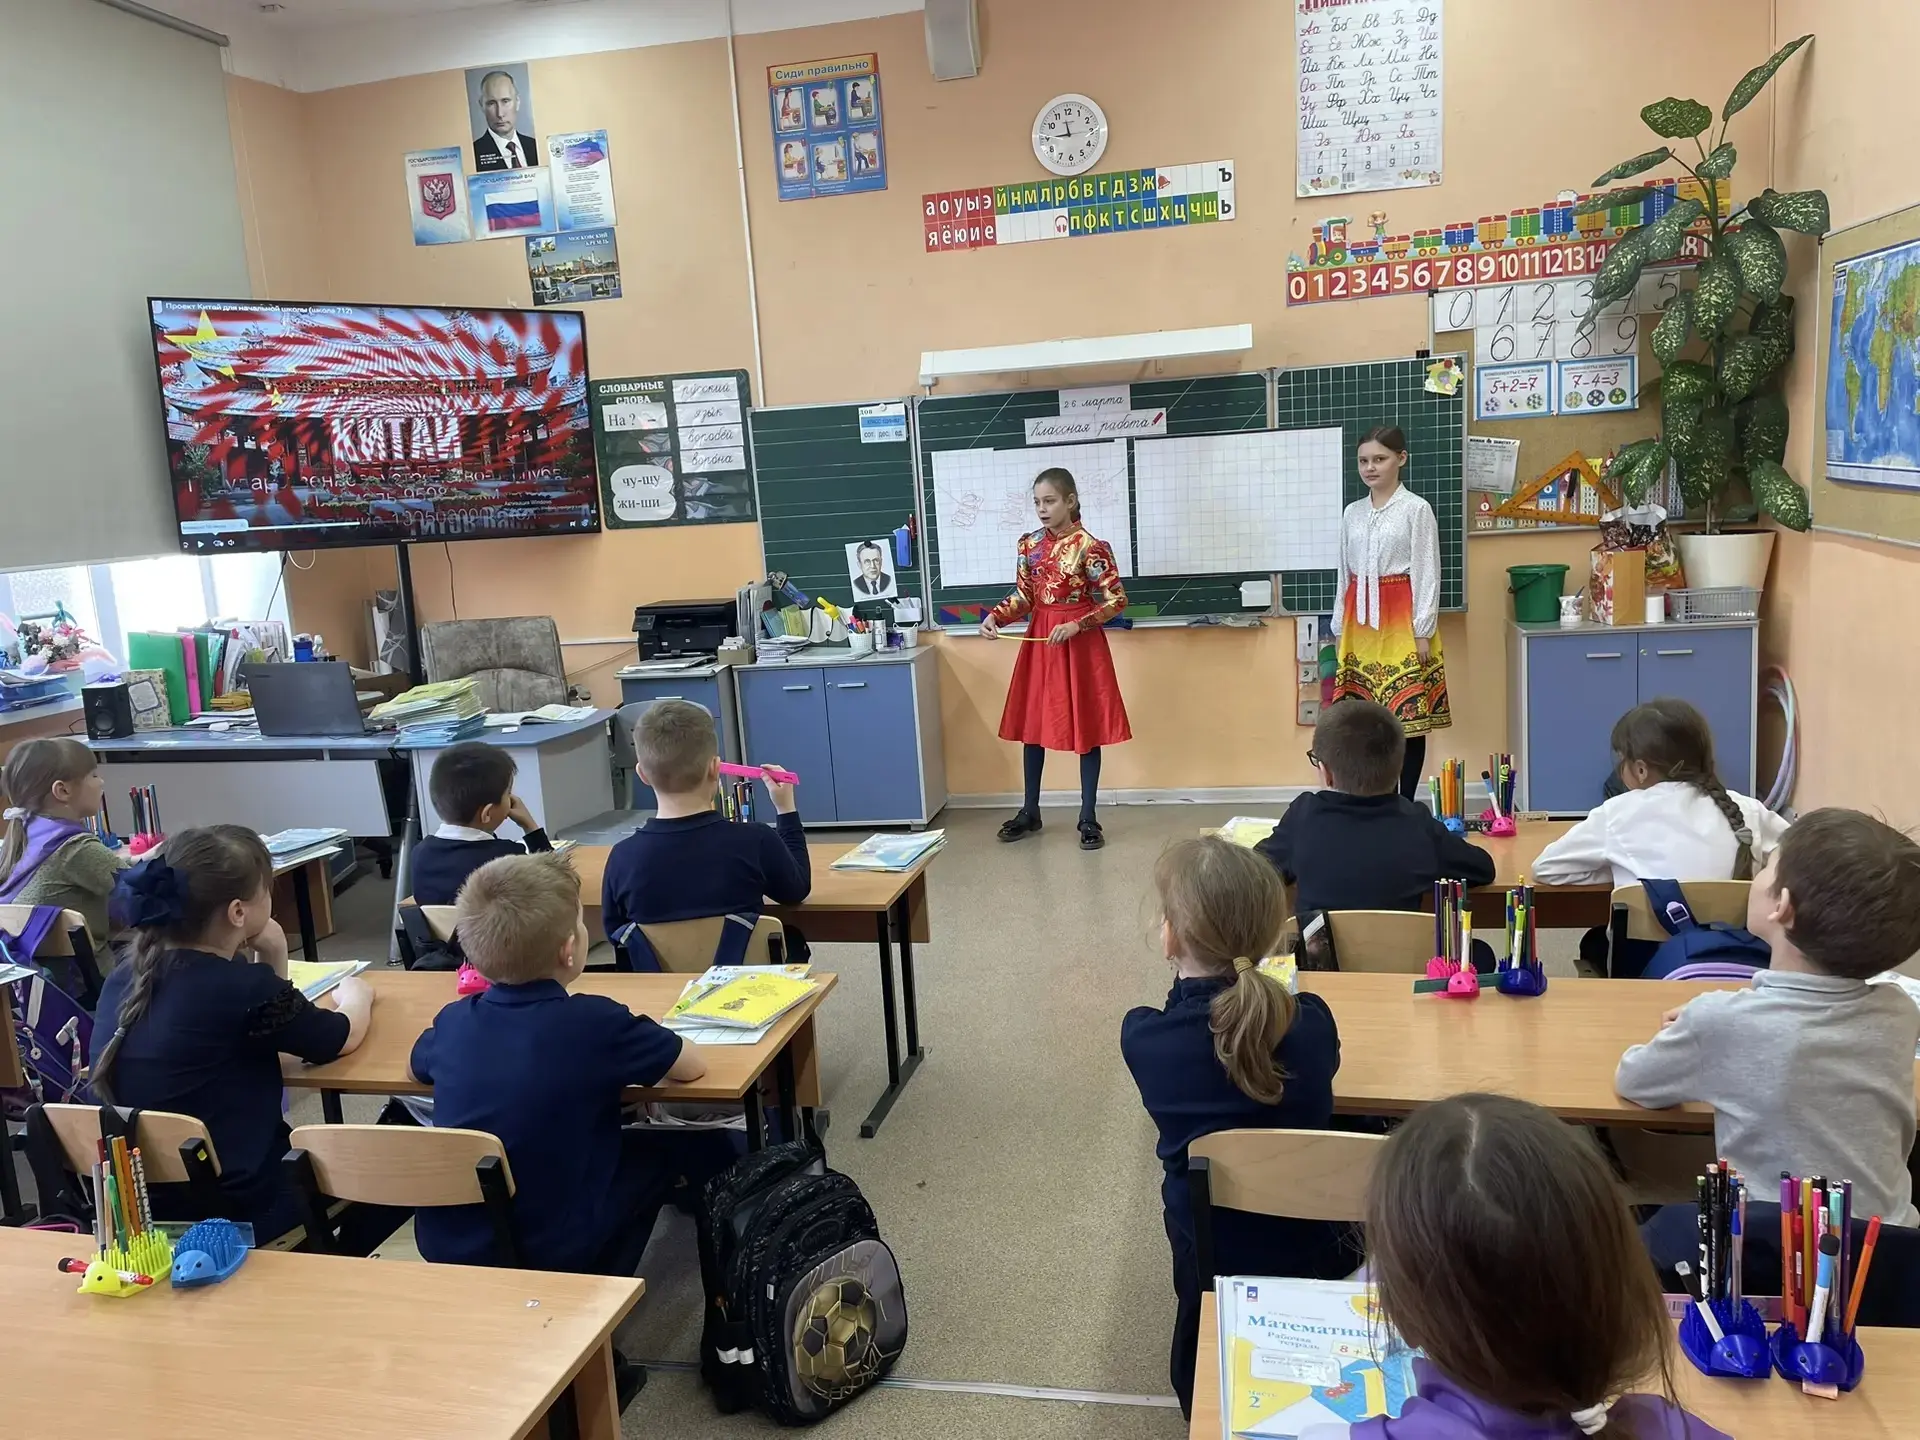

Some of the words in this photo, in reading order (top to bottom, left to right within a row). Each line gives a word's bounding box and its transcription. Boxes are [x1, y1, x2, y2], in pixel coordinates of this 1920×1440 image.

[1300, 21, 1321, 35] Аа
[1332, 17, 1351, 32] Бб
[1362, 14, 1380, 28] Вв
[1392, 10, 1404, 25] Гг
[1416, 7, 1438, 25] Дд
[1301, 57, 1320, 73] Йй
[1327, 55, 1346, 70] Кк
[1354, 53, 1373, 67] Лл
[1381, 50, 1410, 65] Мм
[1419, 45, 1437, 60] Нн
[776, 69, 804, 79] Сиди
[807, 61, 869, 77] правильно
[1300, 78, 1317, 92] Оо
[1326, 74, 1345, 89] Пп
[1360, 71, 1376, 90] Рр
[1389, 68, 1402, 83] Сс
[1412, 64, 1438, 80] Тт
[1301, 96, 1317, 114] Уу
[1326, 93, 1346, 111] Фф
[1358, 90, 1380, 105] Хх
[1390, 87, 1410, 102] Цц
[1420, 84, 1436, 98] Чч
[1301, 114, 1328, 129] Шш
[1342, 111, 1370, 127] Щщ
[1318, 151, 1323, 159] 1
[1342, 149, 1347, 157] 2
[1366, 146, 1371, 155] 3
[1390, 144, 1395, 152] 4
[1414, 142, 1420, 150] 5
[1317, 166, 1323, 174] 6
[1342, 163, 1346, 171] 7
[1365, 161, 1371, 169] 8
[1390, 159, 1395, 167] 9
[1414, 157, 1420, 165] 0
[1290, 277, 1306, 299] 0
[1313, 274, 1323, 296] 1
[1331, 272, 1346, 295] 2
[1352, 269, 1367, 293] 3
[1371, 268, 1389, 291] 4
[1394, 265, 1409, 289] 5
[1414, 262, 1430, 287] 6
[1435, 261, 1452, 285] 7
[1456, 258, 1473, 282] 8
[1478, 256, 1495, 281] 9
[1498, 253, 1518, 278] 10
[1522, 250, 1541, 276] 11
[1543, 247, 1562, 273] 12
[1565, 245, 1584, 271] 13
[1449, 291, 1472, 328] 0
[1497, 287, 1513, 324] 1
[1532, 283, 1555, 321] 2
[1571, 280, 1595, 318] 3
[1653, 273, 1679, 310] 5
[1491, 325, 1514, 361] 6
[1532, 320, 1556, 358] 7
[1571, 322, 1596, 358] 8
[1613, 316, 1637, 354] 9
[599, 381, 664, 393] СЛОВАРНЫЕ
[616, 396, 651, 404] СЛОВА
[1082, 397, 1124, 410] марта
[609, 414, 626, 426] На
[1031, 420, 1090, 437] Классная
[622, 475, 660, 488] чу-щу
[618, 499, 660, 508] жи-ши
[1249, 1395, 1261, 1408] 2
[1350, 1367, 1400, 1420] 1
